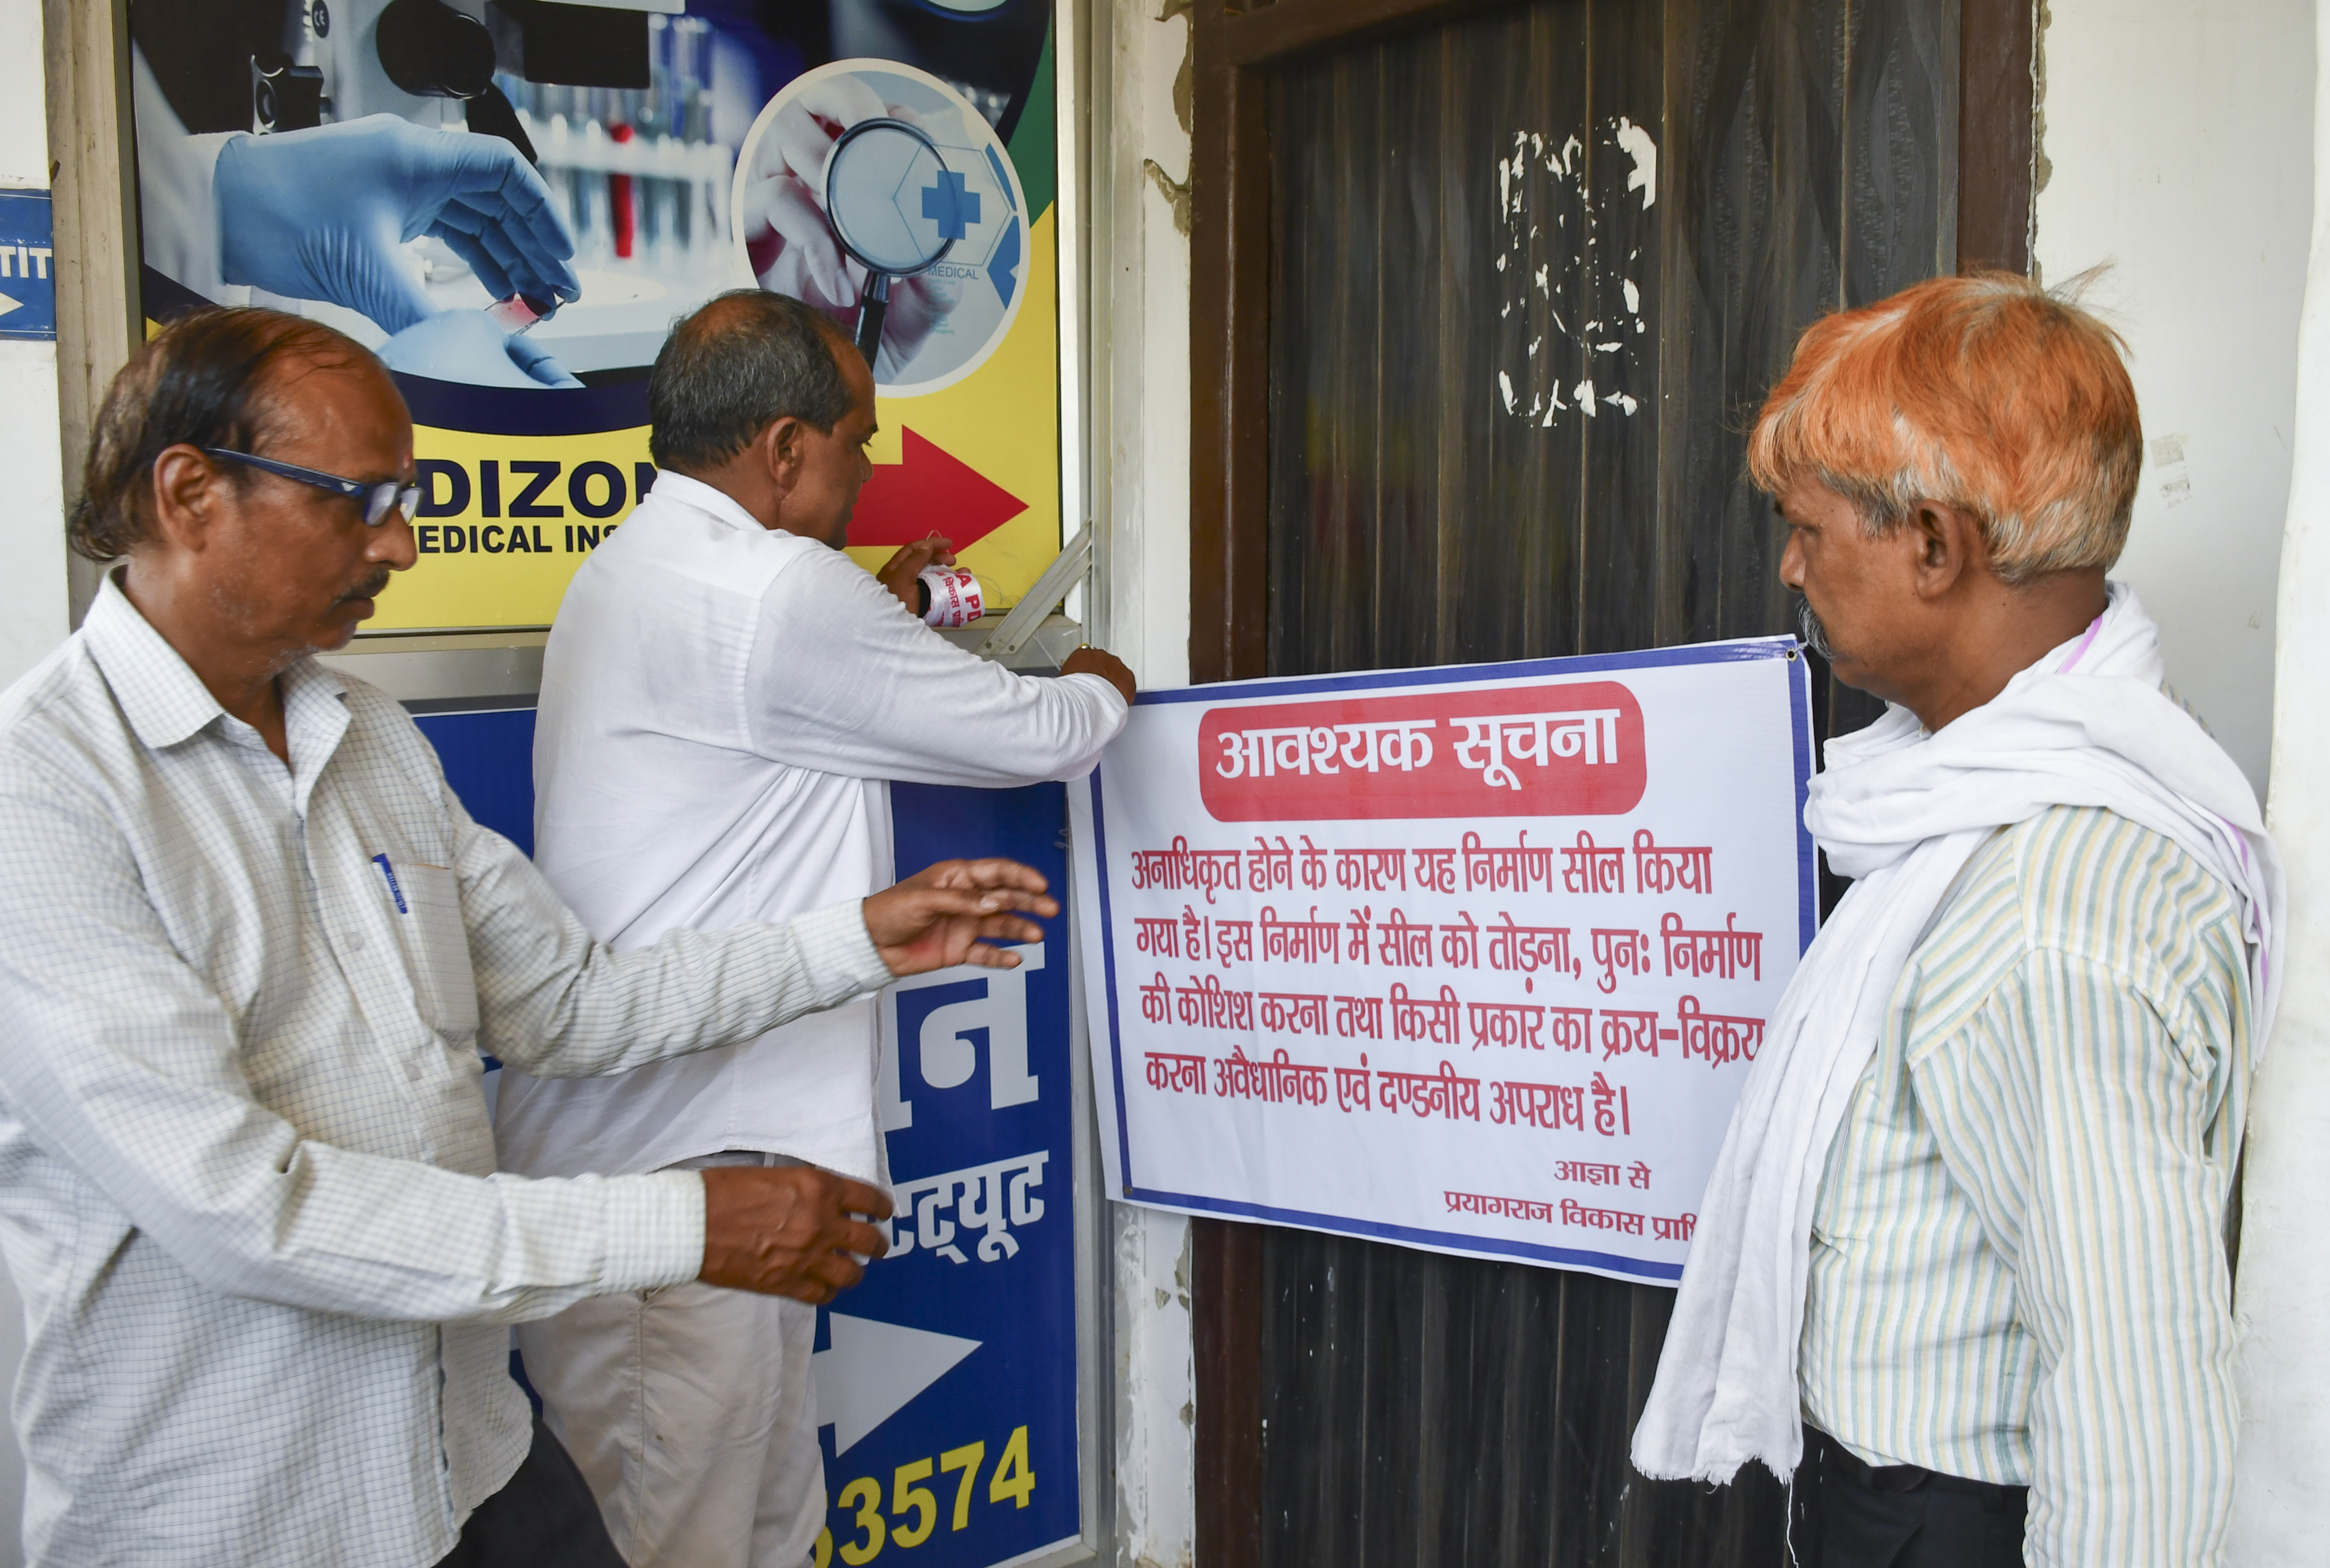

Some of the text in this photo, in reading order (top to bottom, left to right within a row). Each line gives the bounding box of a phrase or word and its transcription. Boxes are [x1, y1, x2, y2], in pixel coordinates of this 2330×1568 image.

[928, 265, 979, 280] MEDICAL
[409, 525, 552, 553] EDICAL
[1216, 709, 1621, 790] आवश्यक सूचना
[1132, 828, 1713, 905] अनाधिकृत होने के कारण यह निर्माण सील किया
[1134, 918, 1180, 958] गया
[1215, 920, 1254, 969] इस
[1259, 905, 1341, 964] निर्माण
[1346, 905, 1372, 965] में
[1376, 907, 1433, 968] सील
[1439, 910, 1480, 969] को
[1660, 911, 1763, 981] निर्माण
[1139, 971, 1172, 1024] की
[1175, 974, 1254, 1031] कोशिश
[1258, 992, 1329, 1036] करना
[1333, 995, 1384, 1040] तथा
[1389, 982, 1461, 1044] किसी
[1466, 1002, 1546, 1051] प्रकार
[1550, 1006, 1593, 1054] का
[1144, 1051, 1207, 1095] करना
[1213, 1044, 1329, 1106] अवैधानिक
[1333, 1052, 1371, 1113] एवं
[1376, 1060, 1481, 1122] दण्डनीय
[1489, 1081, 1584, 1131] अपराध
[1553, 1159, 1652, 1190] आज्ञा से
[1444, 1191, 1553, 1223] प्रयागराज
[1560, 1198, 1645, 1236] विकास
